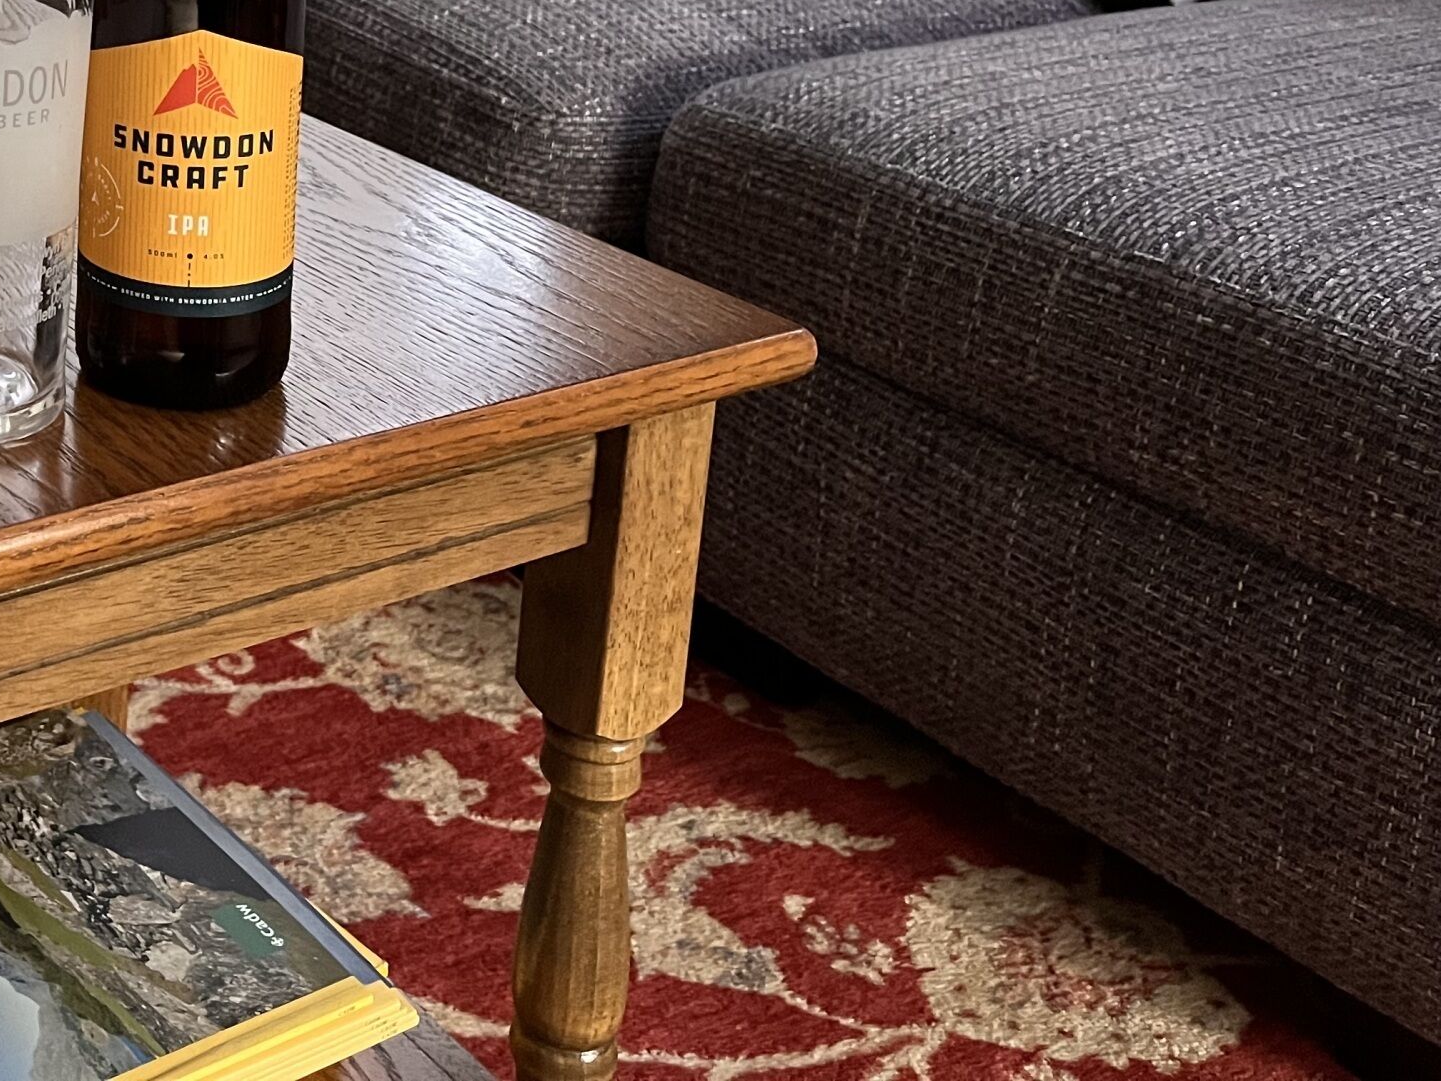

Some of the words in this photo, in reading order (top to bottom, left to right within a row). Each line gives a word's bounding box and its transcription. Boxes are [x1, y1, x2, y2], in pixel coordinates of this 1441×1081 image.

[113, 123, 274, 160] SNOWDON
[137, 159, 249, 190] CRAFT
[167, 213, 209, 237] IPA
[120, 288, 151, 301] BREWED
[154, 294, 175, 303] WITH
[178, 296, 227, 306] SNOWDONIA
[230, 293, 254, 304] WATER
